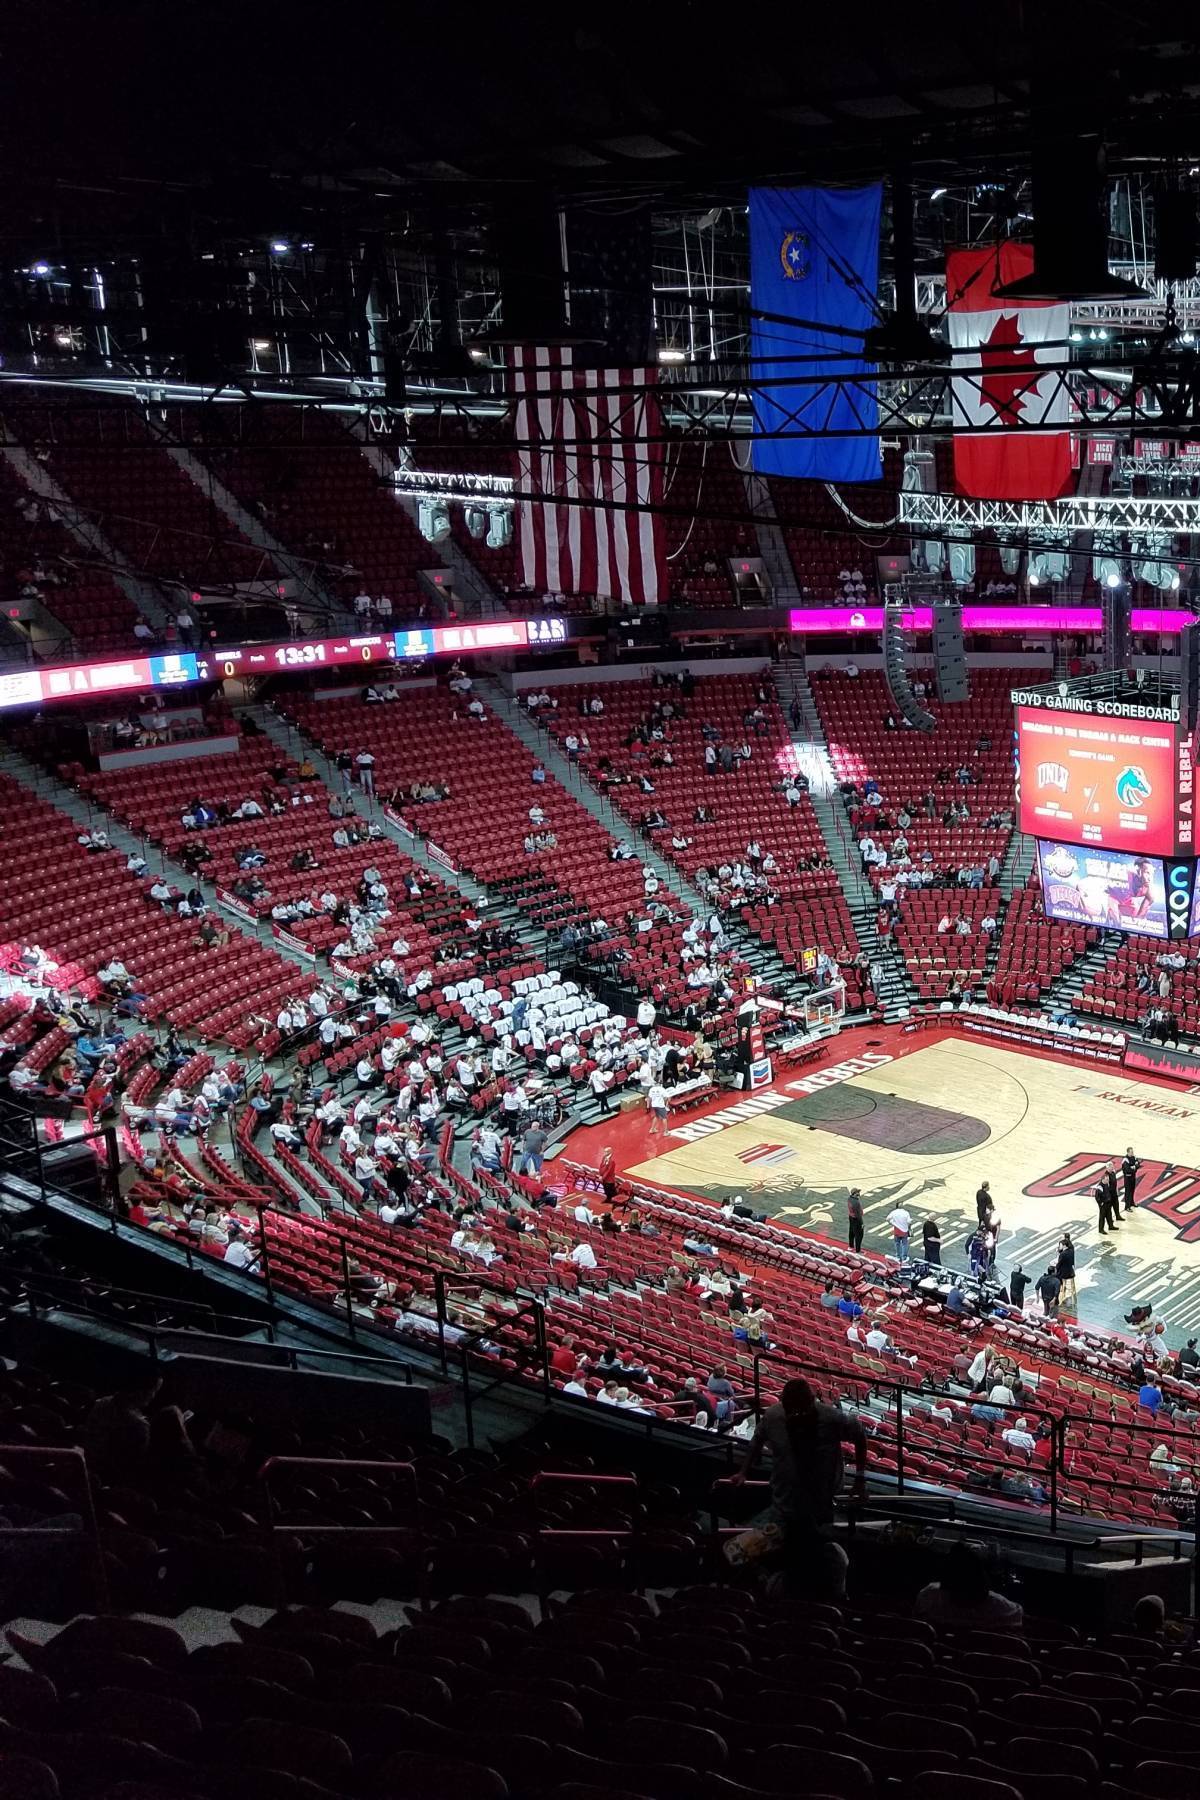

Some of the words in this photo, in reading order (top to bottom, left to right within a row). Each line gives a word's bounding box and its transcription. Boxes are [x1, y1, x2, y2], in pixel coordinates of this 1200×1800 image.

[275, 644, 326, 665] 13:31
[362, 647, 371, 661] 0
[224, 661, 235, 676] 0
[1010, 691, 1042, 706] BOYD
[1045, 695, 1093, 712] GAMING
[1096, 701, 1181, 722] SCOREBOARD
[1179, 799, 1192, 814] A
[1179, 820, 1192, 843] BE
[1169, 865, 1190, 931] COX
[669, 1089, 795, 1142] RUNNIN'
[784, 1052, 894, 1094] REBELS
